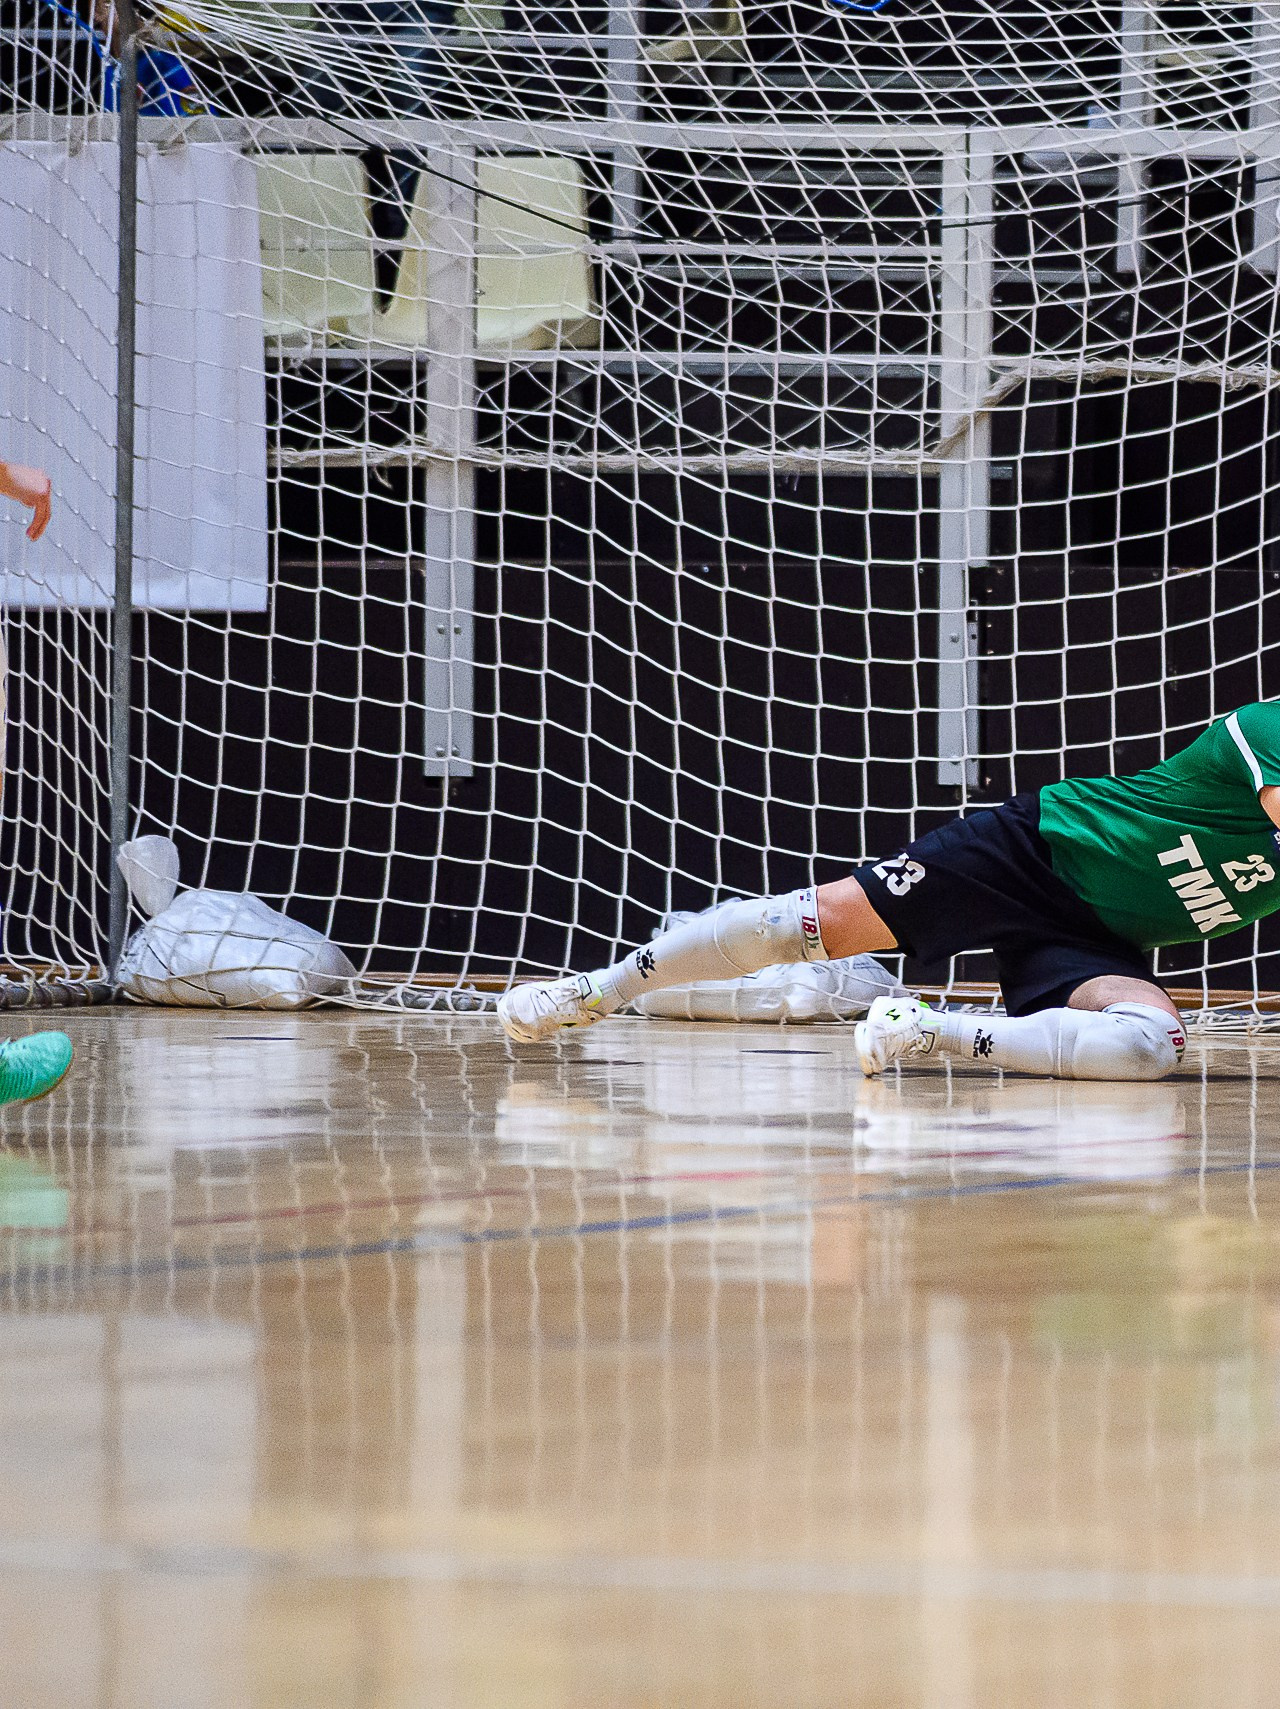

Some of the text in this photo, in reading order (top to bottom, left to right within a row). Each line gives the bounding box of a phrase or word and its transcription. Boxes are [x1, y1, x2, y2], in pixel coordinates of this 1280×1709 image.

[872, 853, 925, 896] 23
[1157, 834, 1242, 933] ТМК
[1221, 854, 1276, 892] 23
